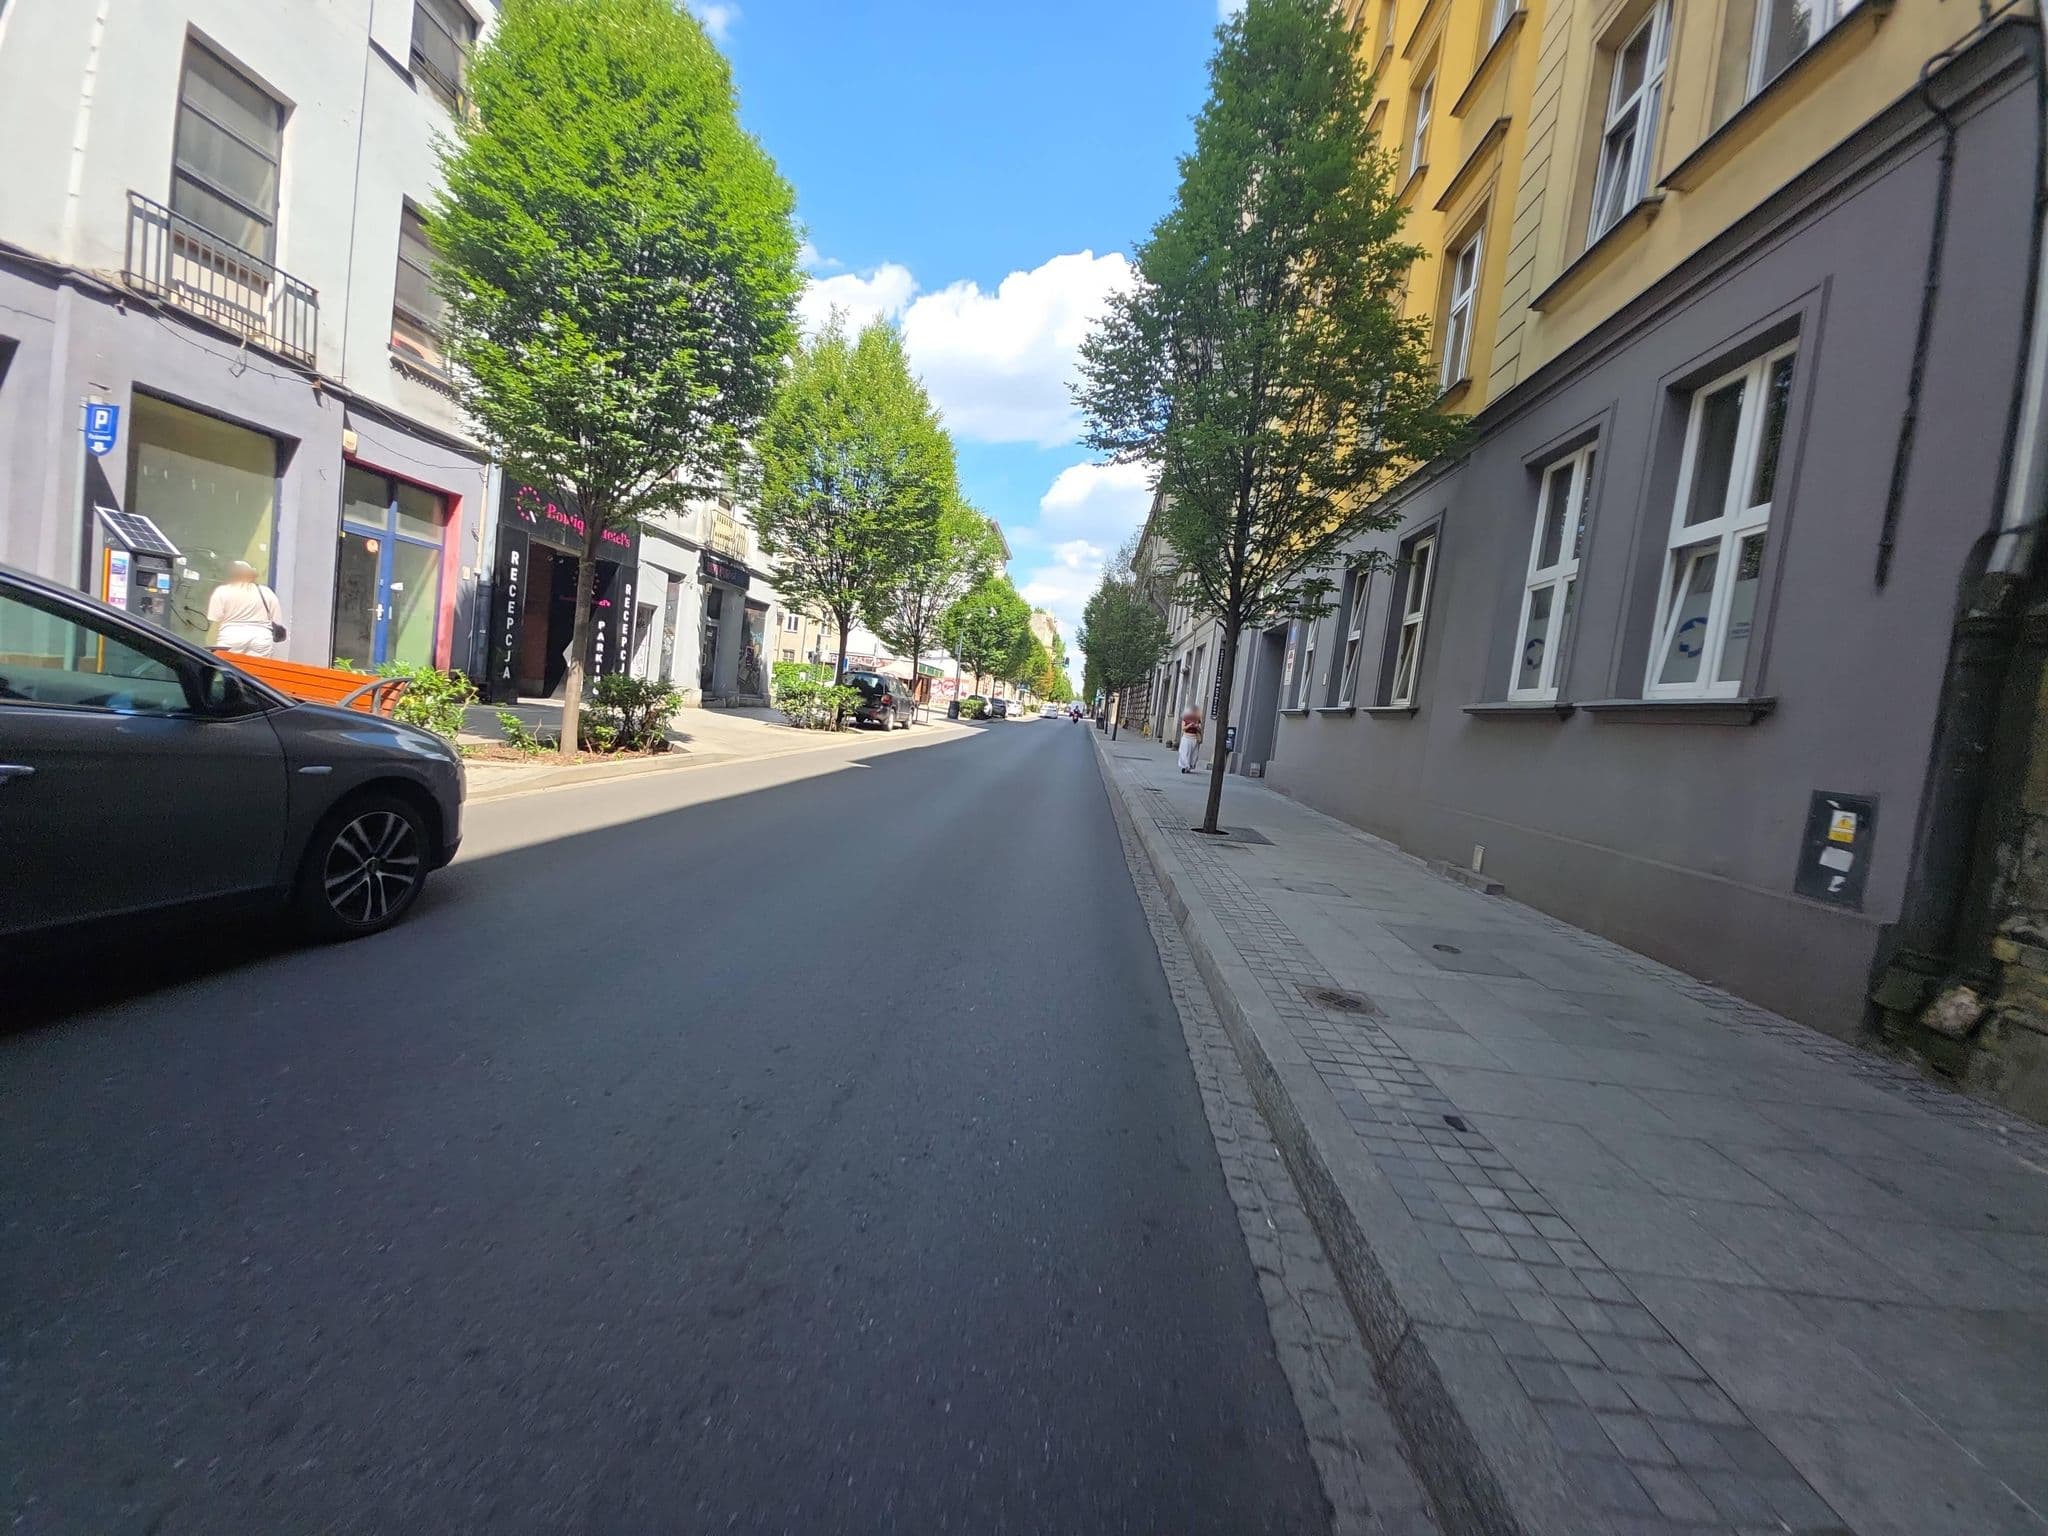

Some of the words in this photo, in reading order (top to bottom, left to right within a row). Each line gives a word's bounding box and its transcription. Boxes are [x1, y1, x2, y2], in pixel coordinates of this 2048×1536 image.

[95, 410, 108, 429] P
[546, 503, 586, 537] Boutiq
[502, 550, 520, 679] RECEPCJA
[619, 583, 632, 675] RECEPCJ
